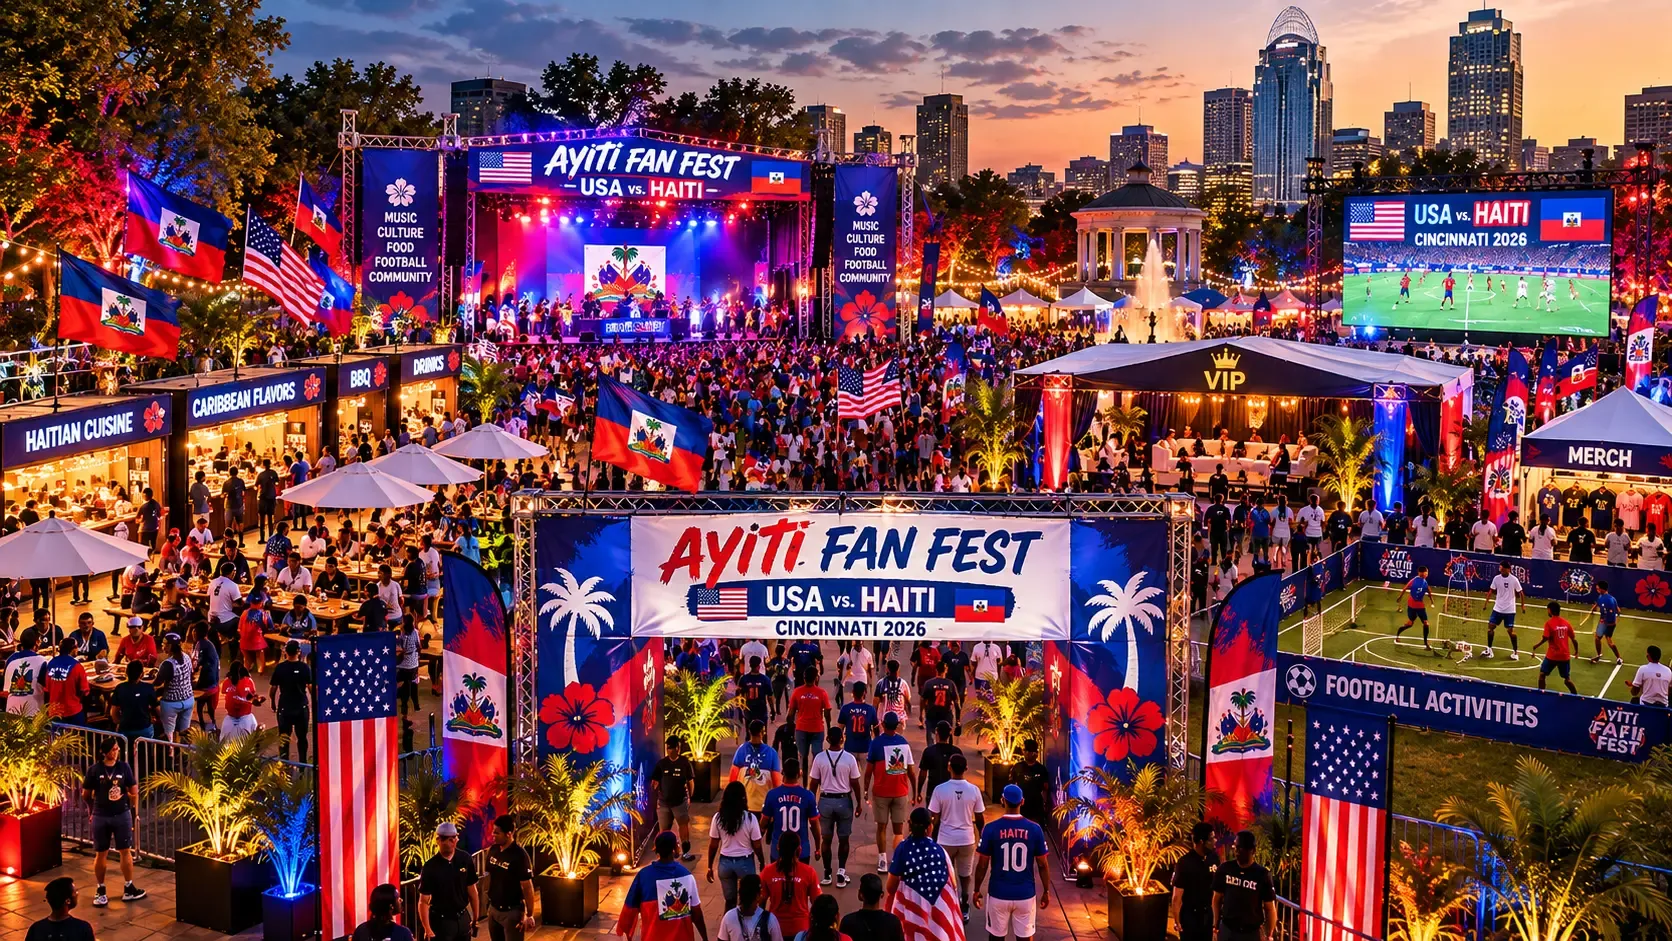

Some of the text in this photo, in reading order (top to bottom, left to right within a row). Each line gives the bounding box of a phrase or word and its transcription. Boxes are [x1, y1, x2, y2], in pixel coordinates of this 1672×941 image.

[625, 148, 677, 174] FAN
[679, 152, 742, 181] FEST
[580, 178, 623, 197] USA
[651, 181, 703, 199] HAITI
[384, 212, 417, 223] MUSIC
[1414, 204, 1452, 224] USA
[1475, 202, 1529, 224] HAITI
[377, 226, 424, 238] CULTURE
[852, 221, 879, 231] MUSIC
[387, 242, 414, 252] FOOD
[846, 234, 885, 244] CULTURE
[1414, 233, 1528, 246] CINCINNATI 2026
[375, 256, 427, 268] FOOTBALL
[845, 260, 887, 269] FOOTBALL
[369, 271, 432, 282] COMMUNITY
[840, 273, 891, 282] COMMUNITY
[413, 355, 444, 376] DRINKS
[350, 367, 371, 388] BBQ
[1203, 370, 1246, 390] VIP
[192, 382, 296, 419] CARIBBEAN FLAVORS
[25, 411, 133, 453] HAITIAN CUISINE
[1568, 446, 1632, 468] MERCH
[820, 525, 918, 573] FAN
[925, 527, 1044, 576] FEST
[765, 585, 825, 613] USA
[861, 586, 936, 614] HAITI
[775, 620, 926, 637] CINCINNATI 2026
[1326, 674, 1539, 729] FOOTBALL ACTIVITIES
[1596, 735, 1641, 756] FEST
[779, 805, 801, 833] 10
[1000, 827, 1029, 840] HAITI
[1000, 842, 1028, 873] 10
